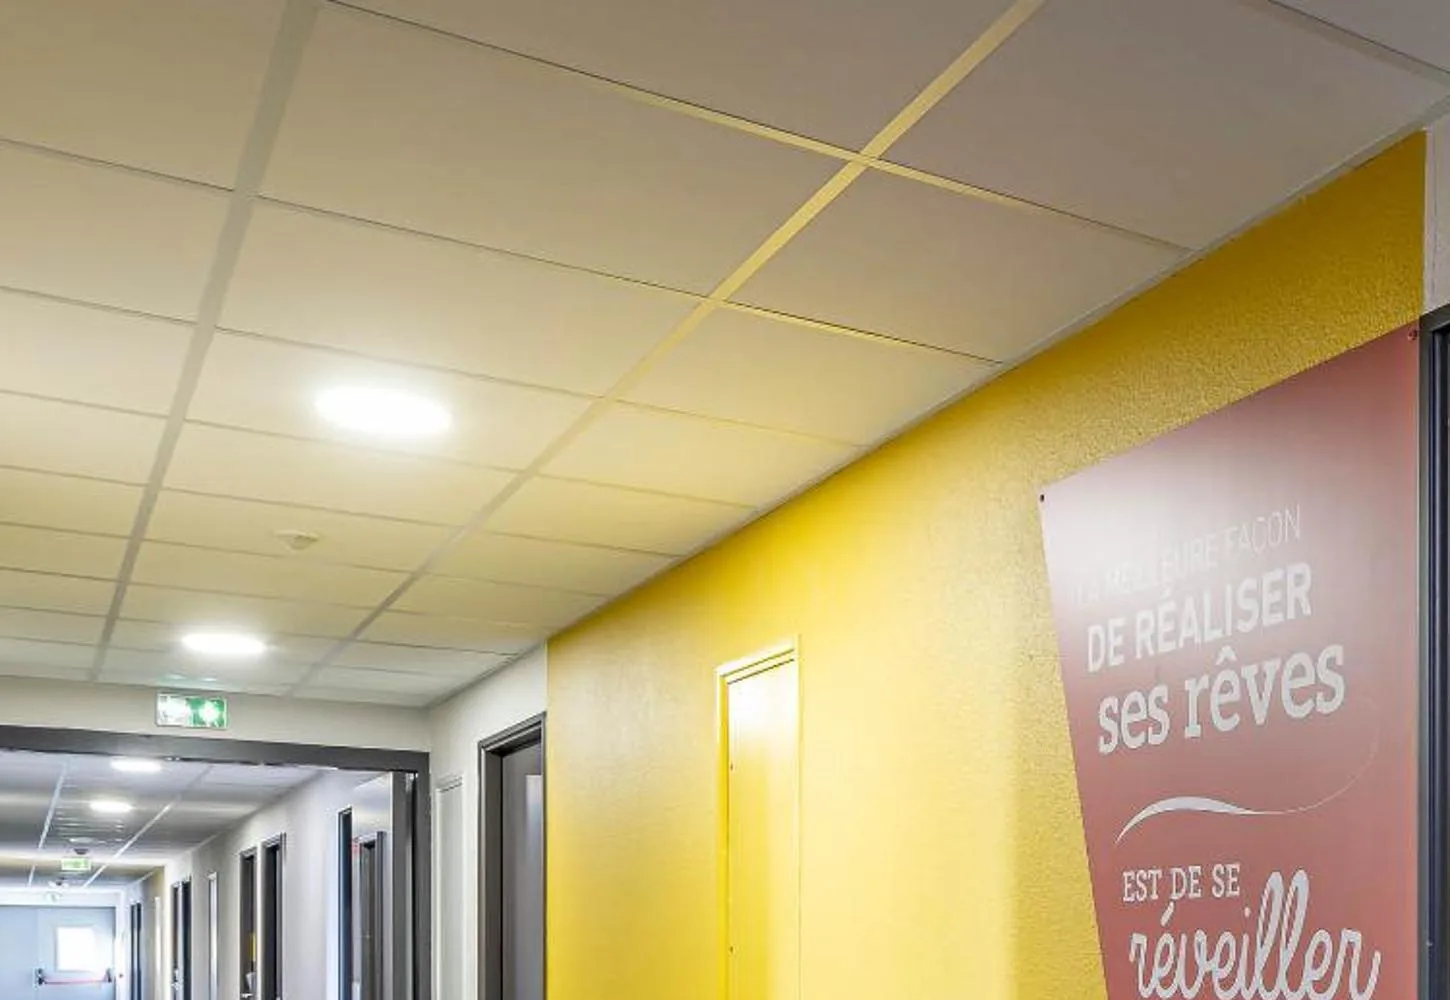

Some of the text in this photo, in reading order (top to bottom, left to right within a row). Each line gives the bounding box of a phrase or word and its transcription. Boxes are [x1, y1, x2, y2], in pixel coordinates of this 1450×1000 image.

[1088, 561, 1313, 673] DE RÉALISER
[1099, 645, 1346, 754] ses rêves
[1122, 863, 1241, 902] EST DE SE
